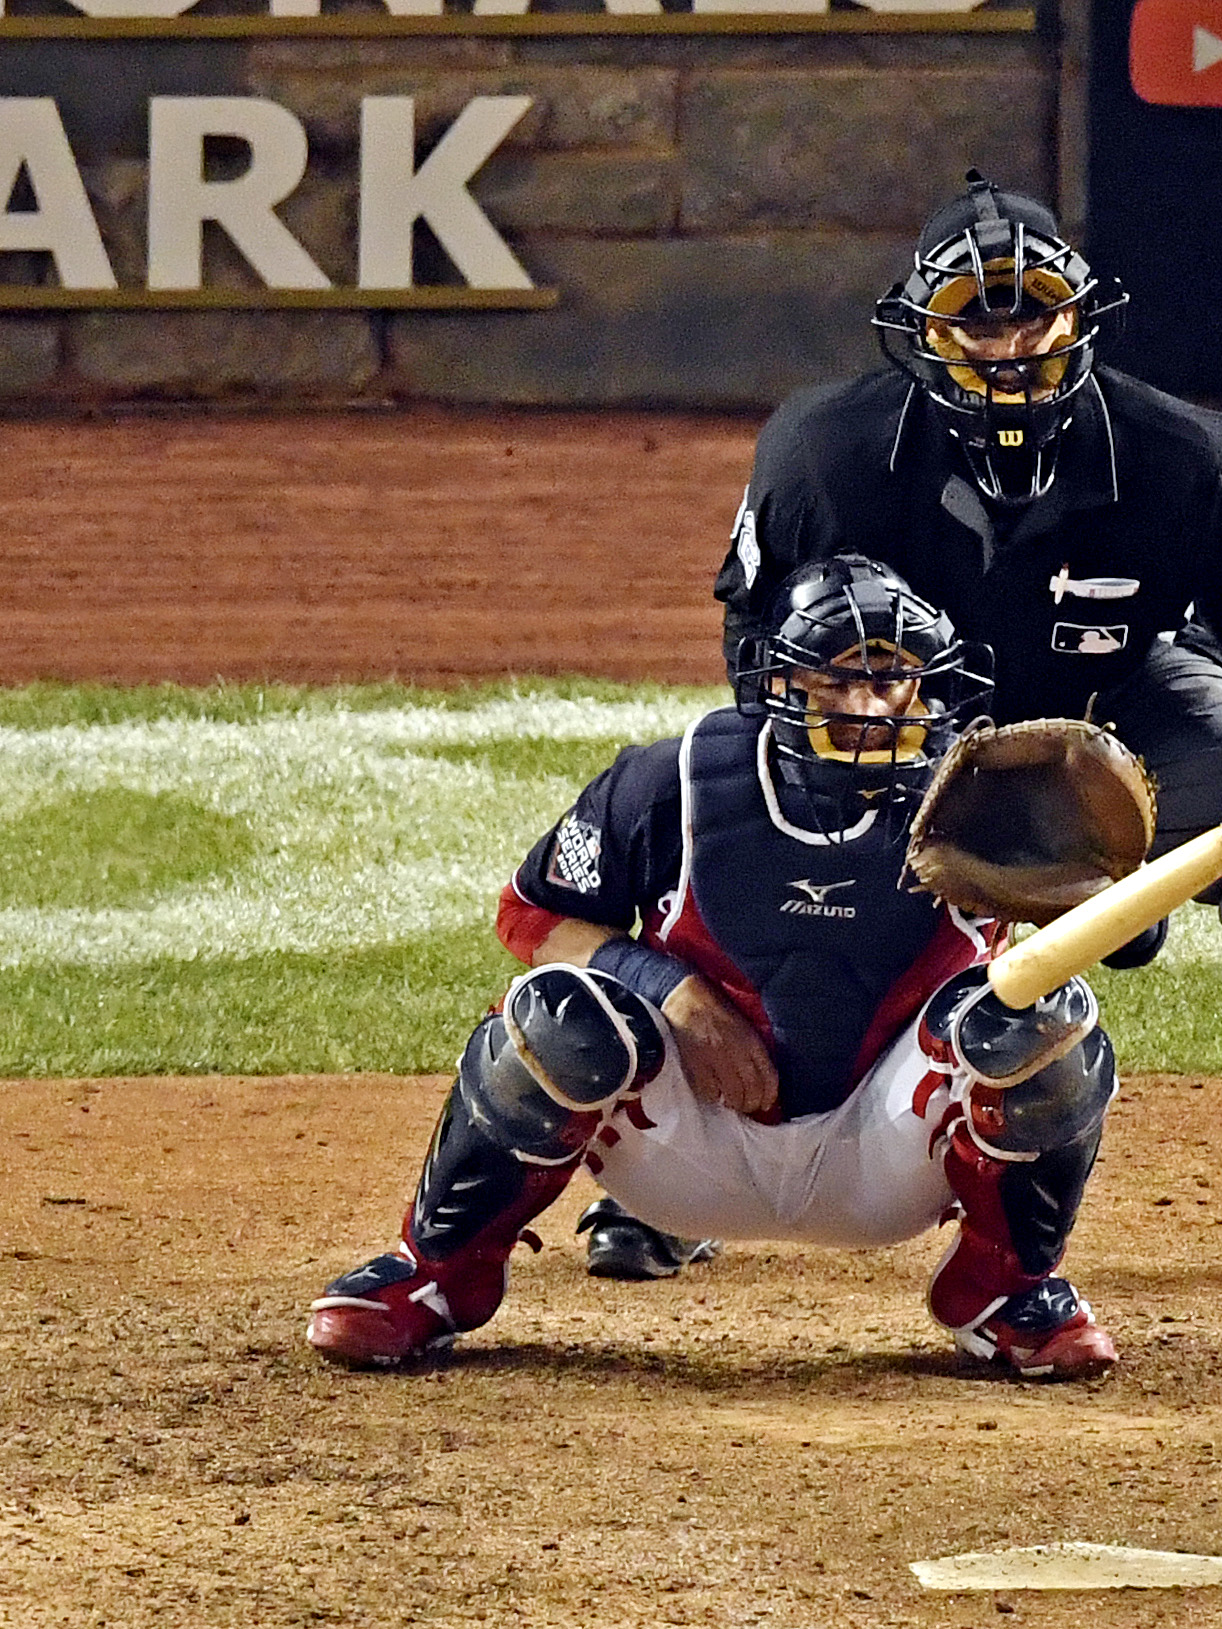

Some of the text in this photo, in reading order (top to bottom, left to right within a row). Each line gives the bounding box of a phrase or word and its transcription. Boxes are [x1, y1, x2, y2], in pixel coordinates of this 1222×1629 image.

[556, 827, 591, 894] SERIES
[567, 810, 602, 888] WORLD
[780, 900, 856, 919] MIZUNO
